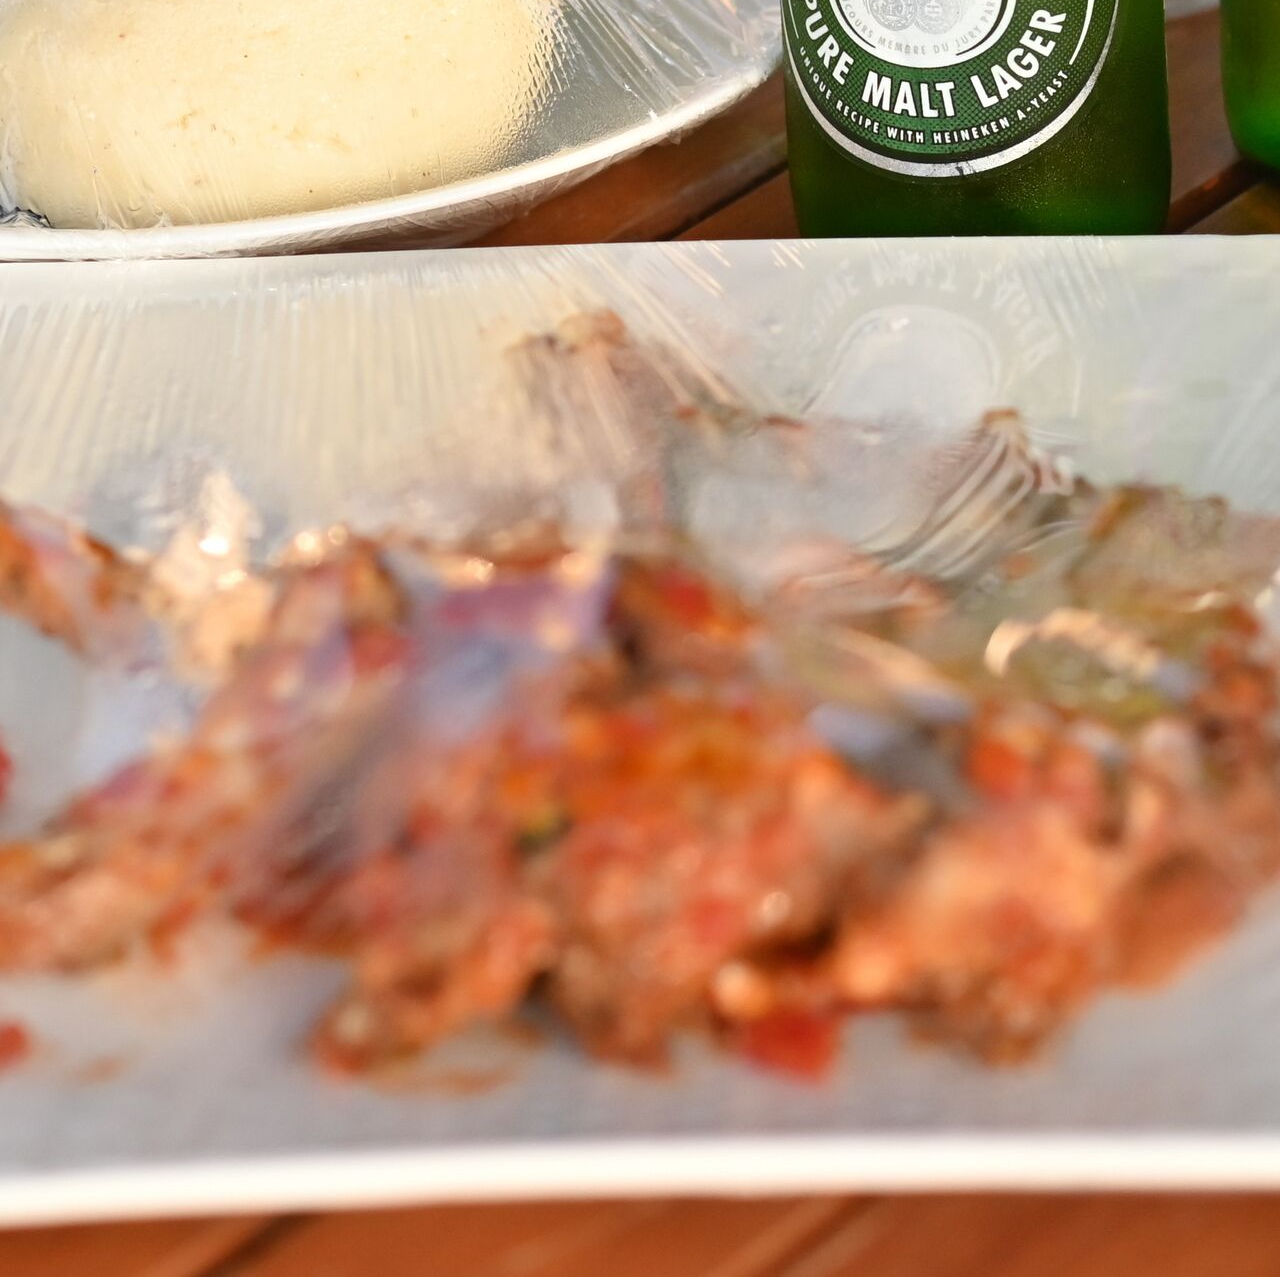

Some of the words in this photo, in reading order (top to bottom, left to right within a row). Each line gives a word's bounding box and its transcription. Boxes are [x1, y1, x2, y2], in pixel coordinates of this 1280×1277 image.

[861, 70, 955, 119] MALT
[970, 9, 1067, 109] LAGER
[877, 36, 926, 56] MEMBRE
[933, 43, 950, 53] DU
[955, 24, 983, 51] JURY
[799, 46, 833, 101] UNIQUE
[835, 99, 880, 135] RECIPE
[887, 125, 924, 144] WITH
[933, 118, 1010, 145] HEINEKEN
[1015, 69, 1069, 122] A-YEAST
